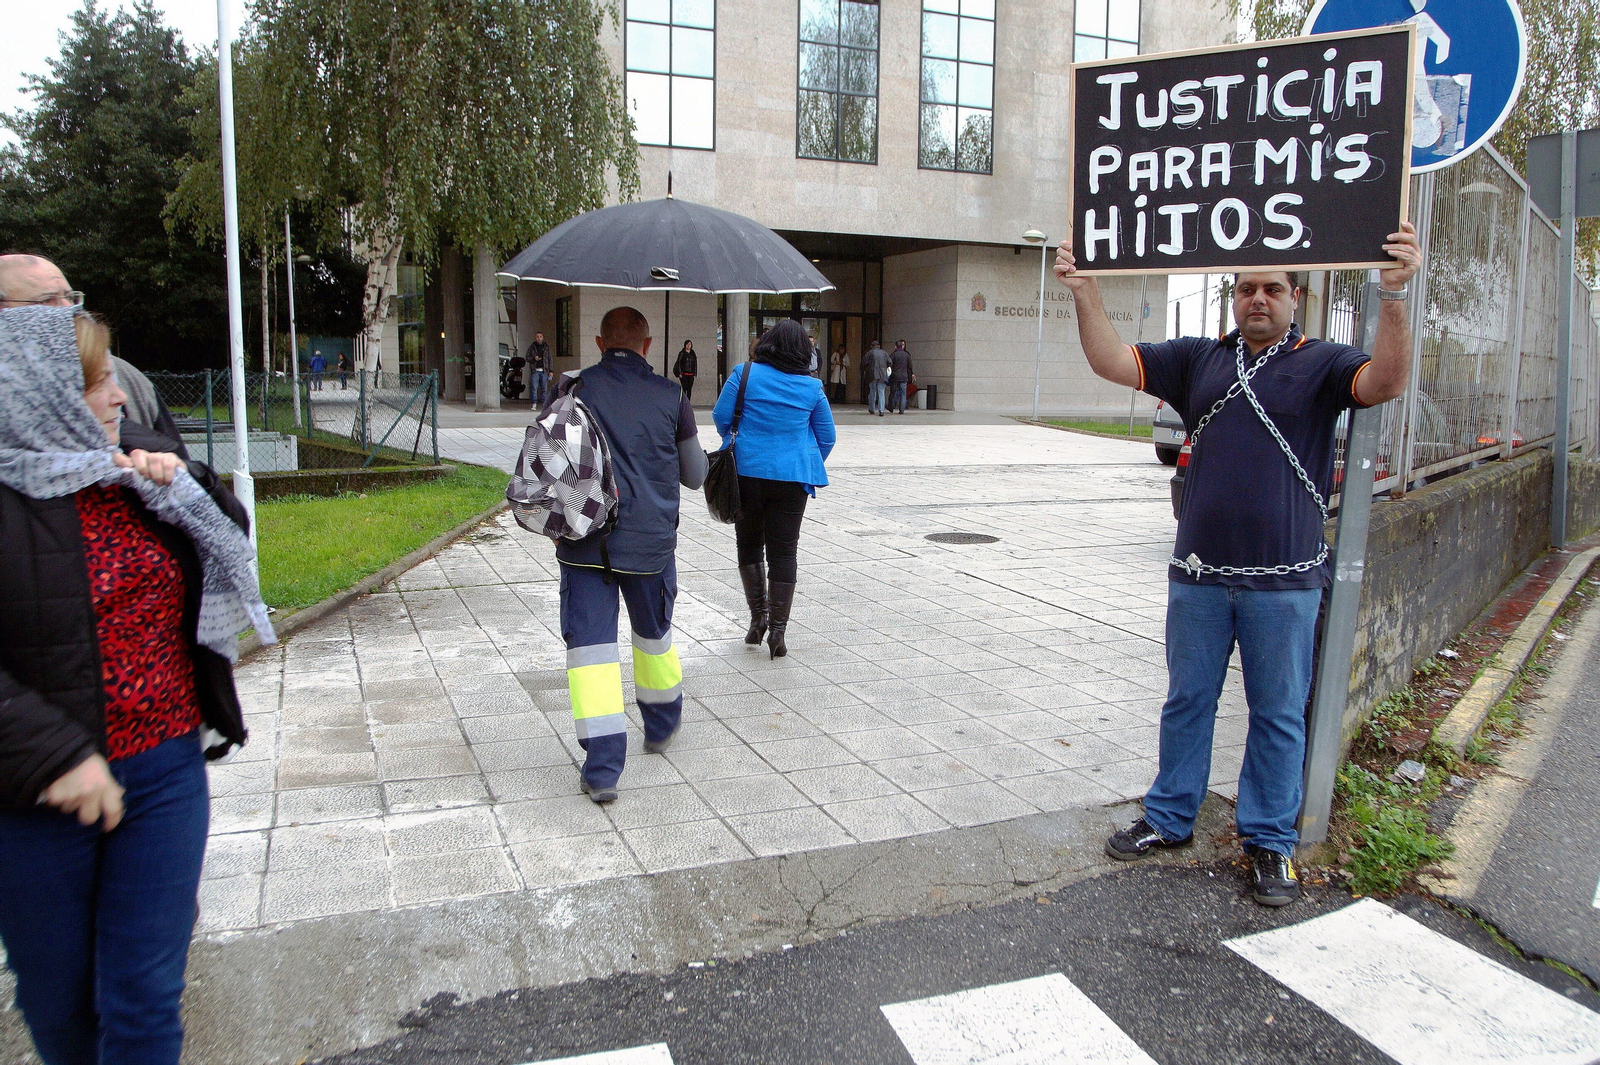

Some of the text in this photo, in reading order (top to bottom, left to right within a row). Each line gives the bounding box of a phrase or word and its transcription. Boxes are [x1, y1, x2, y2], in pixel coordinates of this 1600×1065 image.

[1088, 142, 1231, 195] PARA
[1035, 290, 1074, 302] XULGA
[1056, 308, 1071, 319] DA
